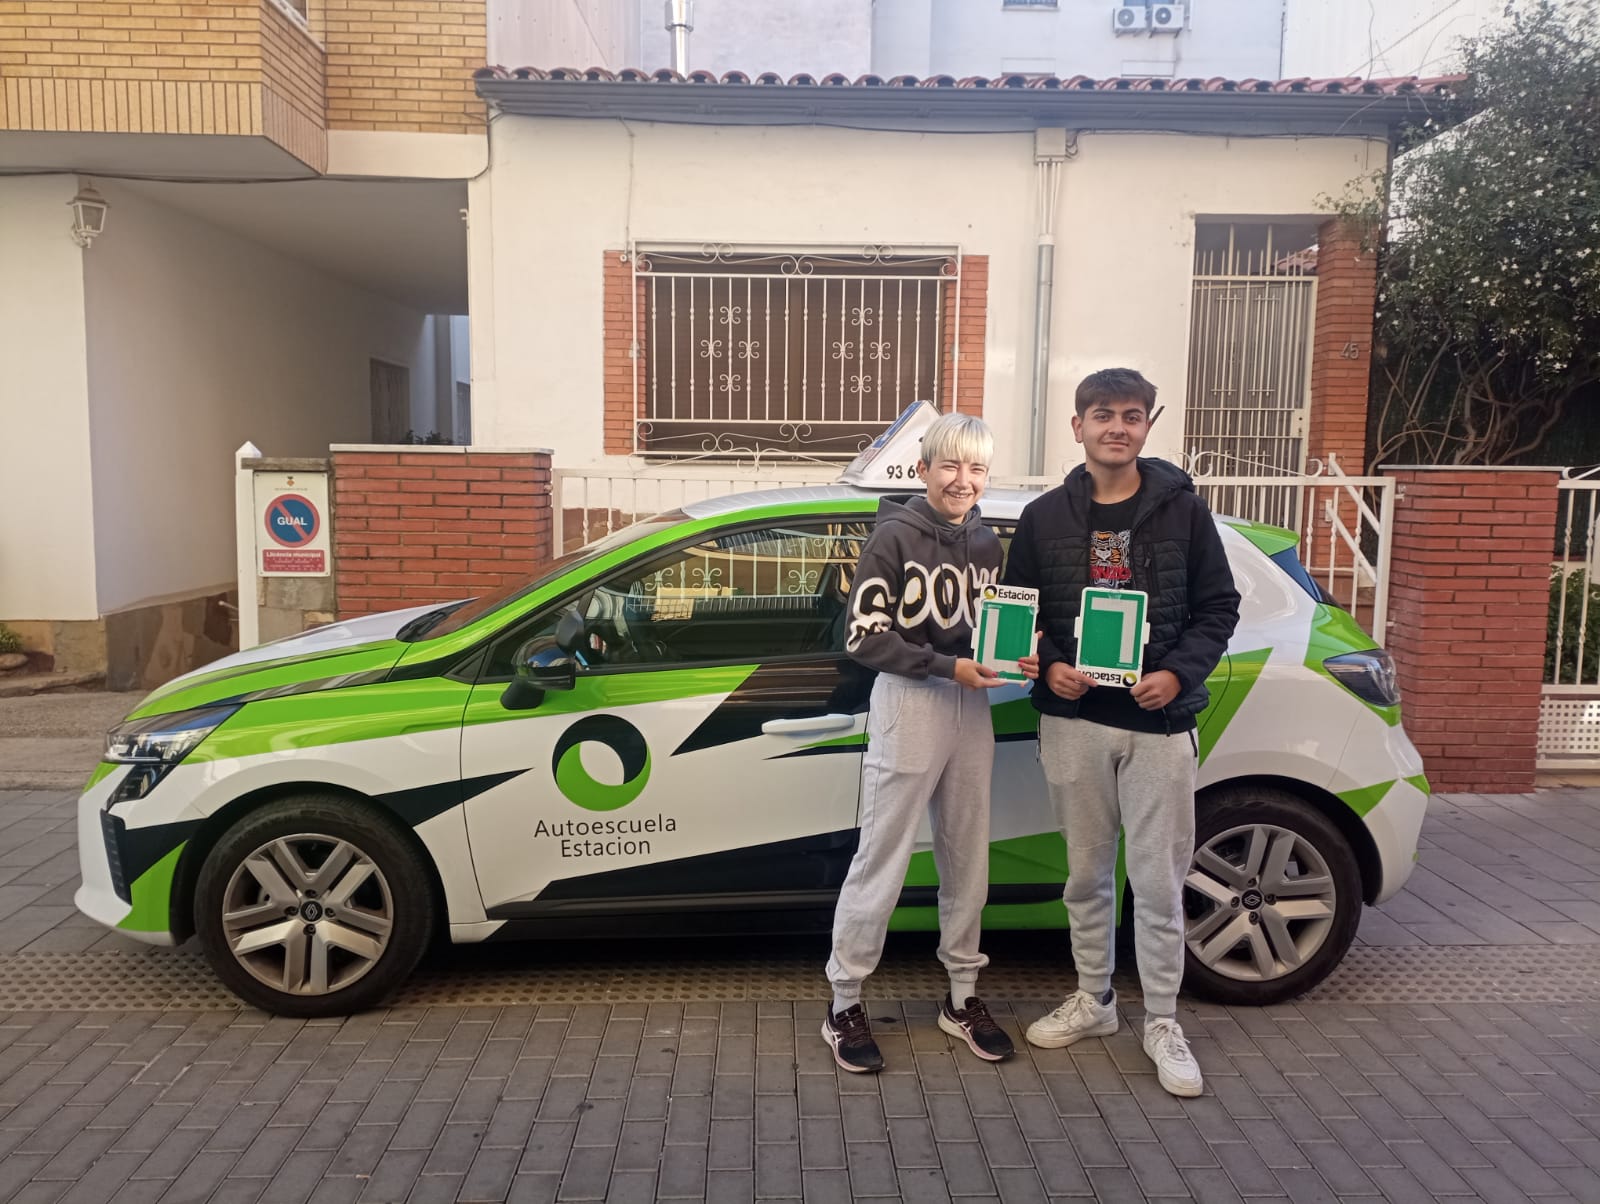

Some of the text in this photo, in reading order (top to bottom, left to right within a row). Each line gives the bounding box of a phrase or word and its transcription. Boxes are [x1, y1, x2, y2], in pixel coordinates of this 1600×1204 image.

[1340, 342, 1359, 359] 45
[886, 465, 920, 479] 93 6
[277, 516, 308, 526] GUAL
[998, 588, 1036, 601] Estacion
[1079, 670, 1121, 684] Estacio
[533, 813, 677, 838] Autoescuela
[561, 836, 651, 858] Estacion
